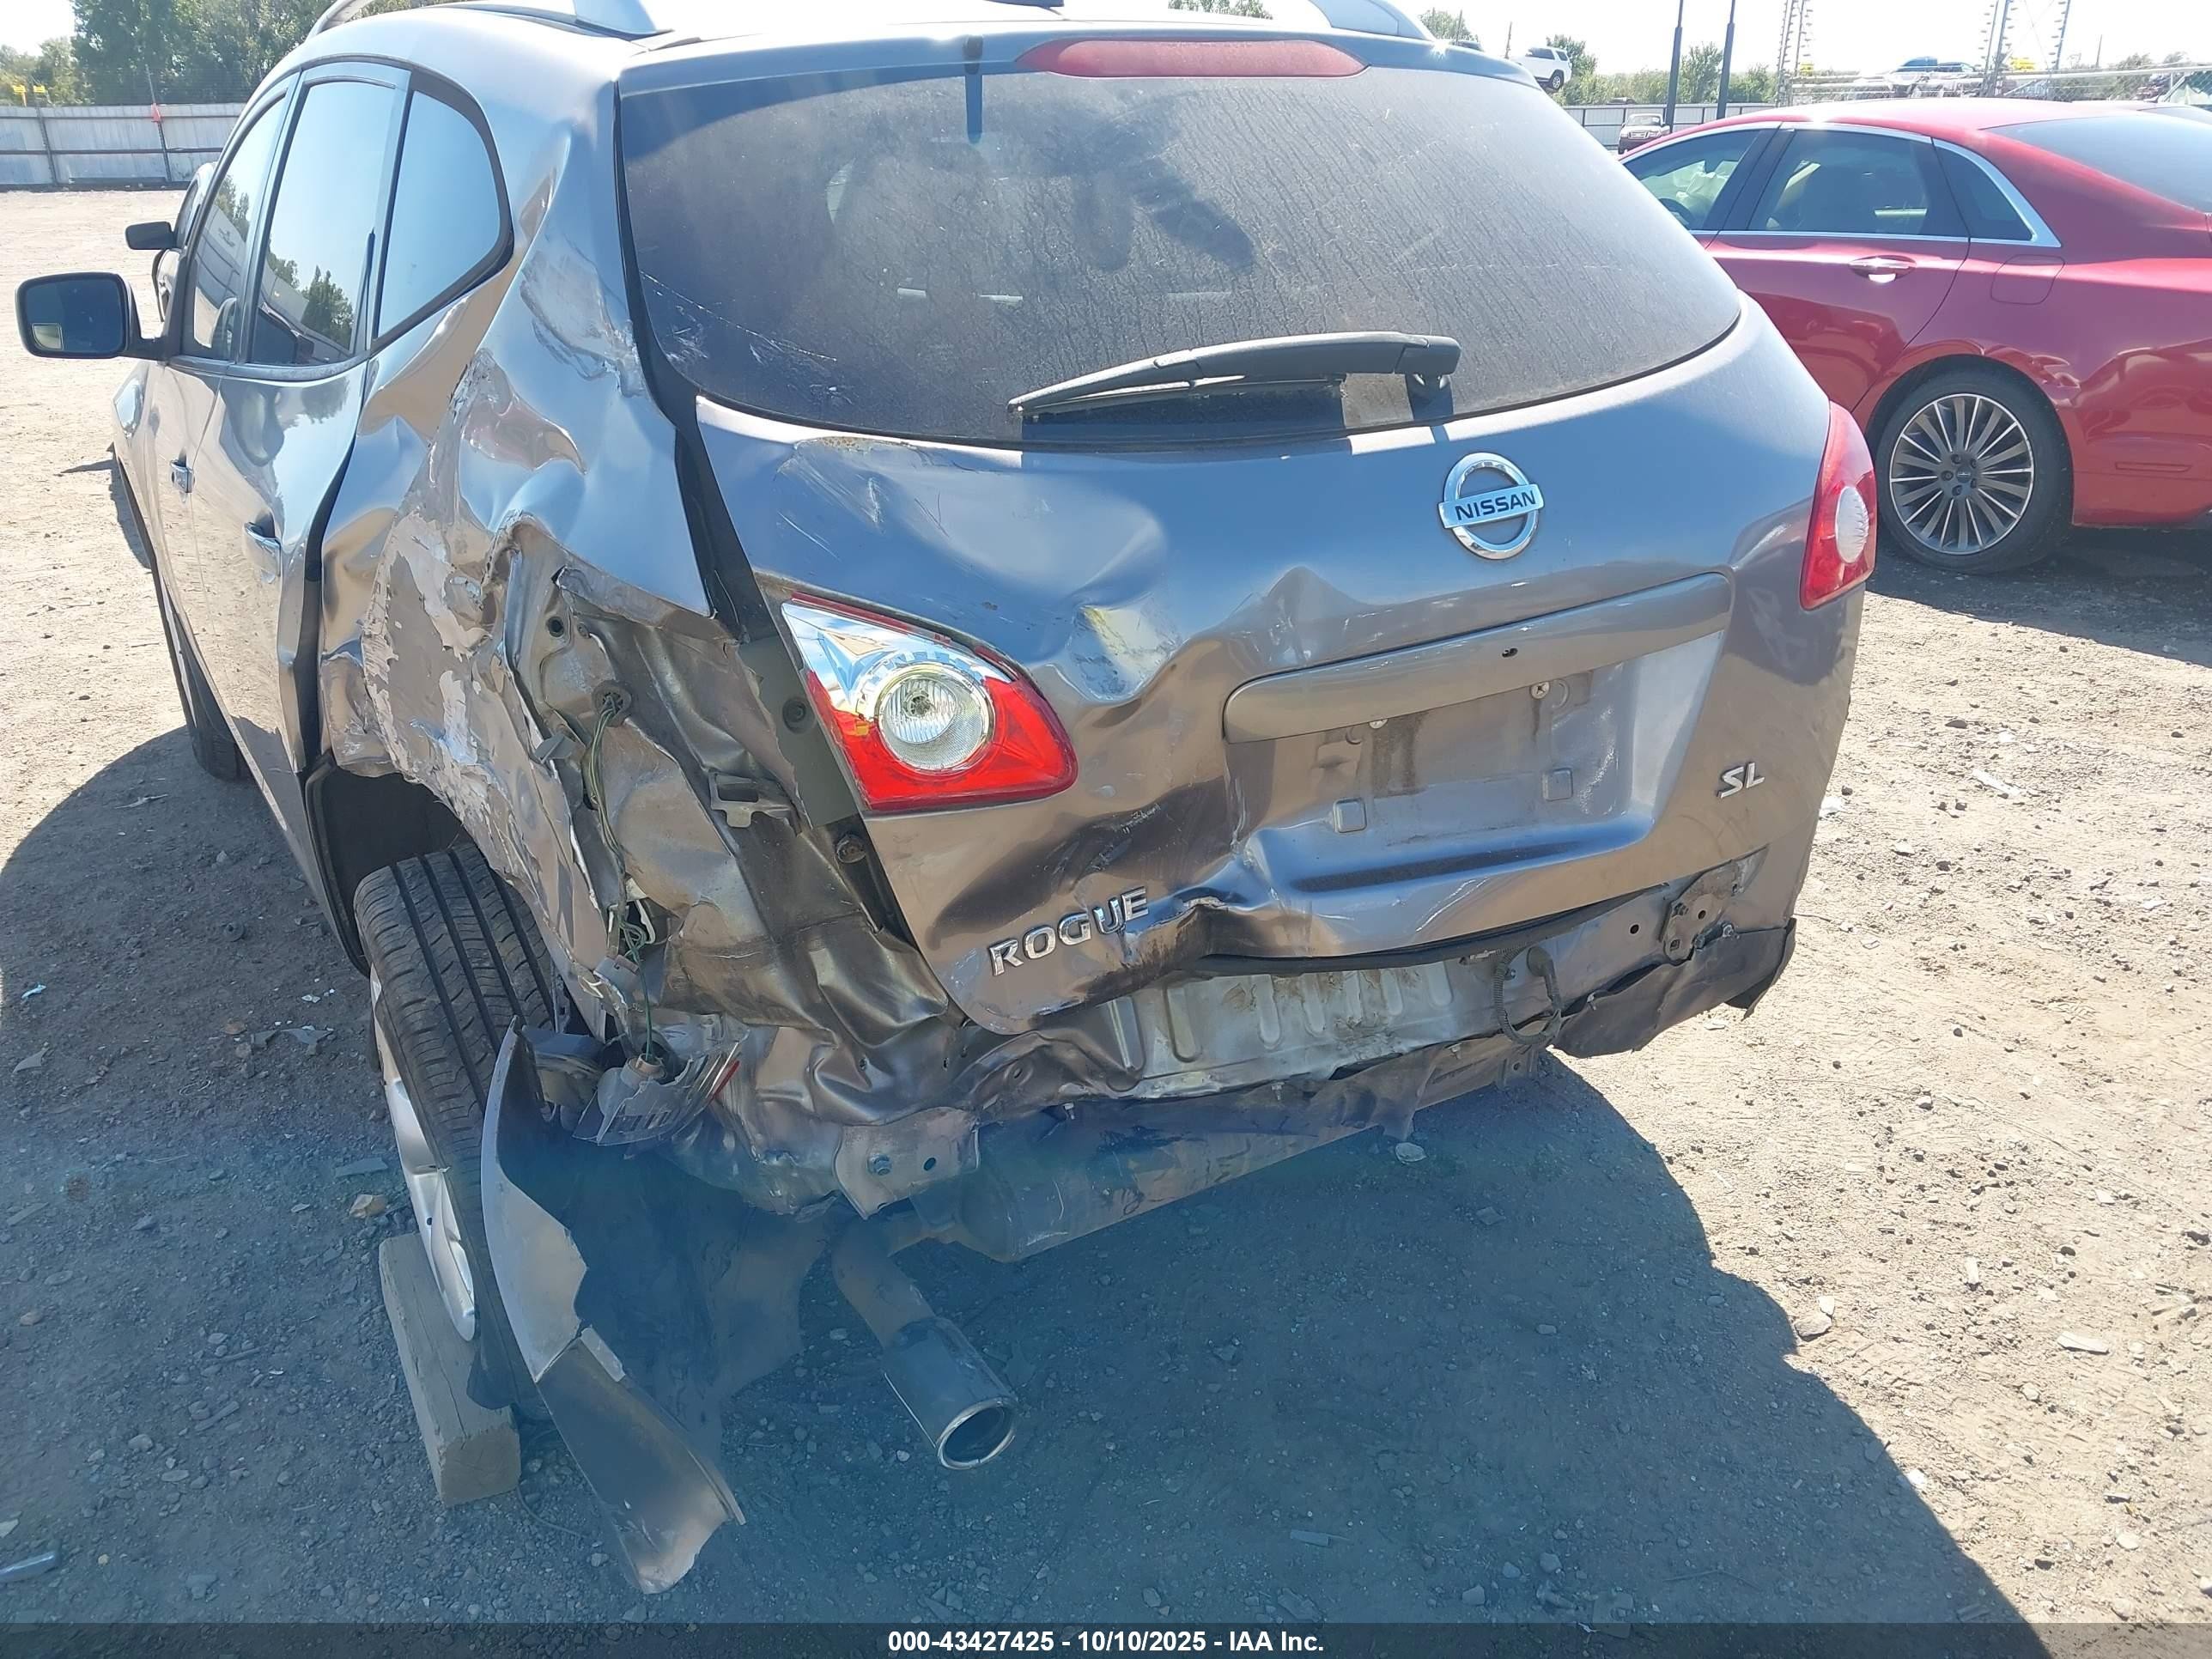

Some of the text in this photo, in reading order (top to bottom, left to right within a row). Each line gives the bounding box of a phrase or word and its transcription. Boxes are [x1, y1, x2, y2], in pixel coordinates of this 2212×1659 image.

[1455, 490, 1536, 521] NISSAN
[1717, 762, 1765, 799] SL
[988, 886, 1149, 976] ROGUE
